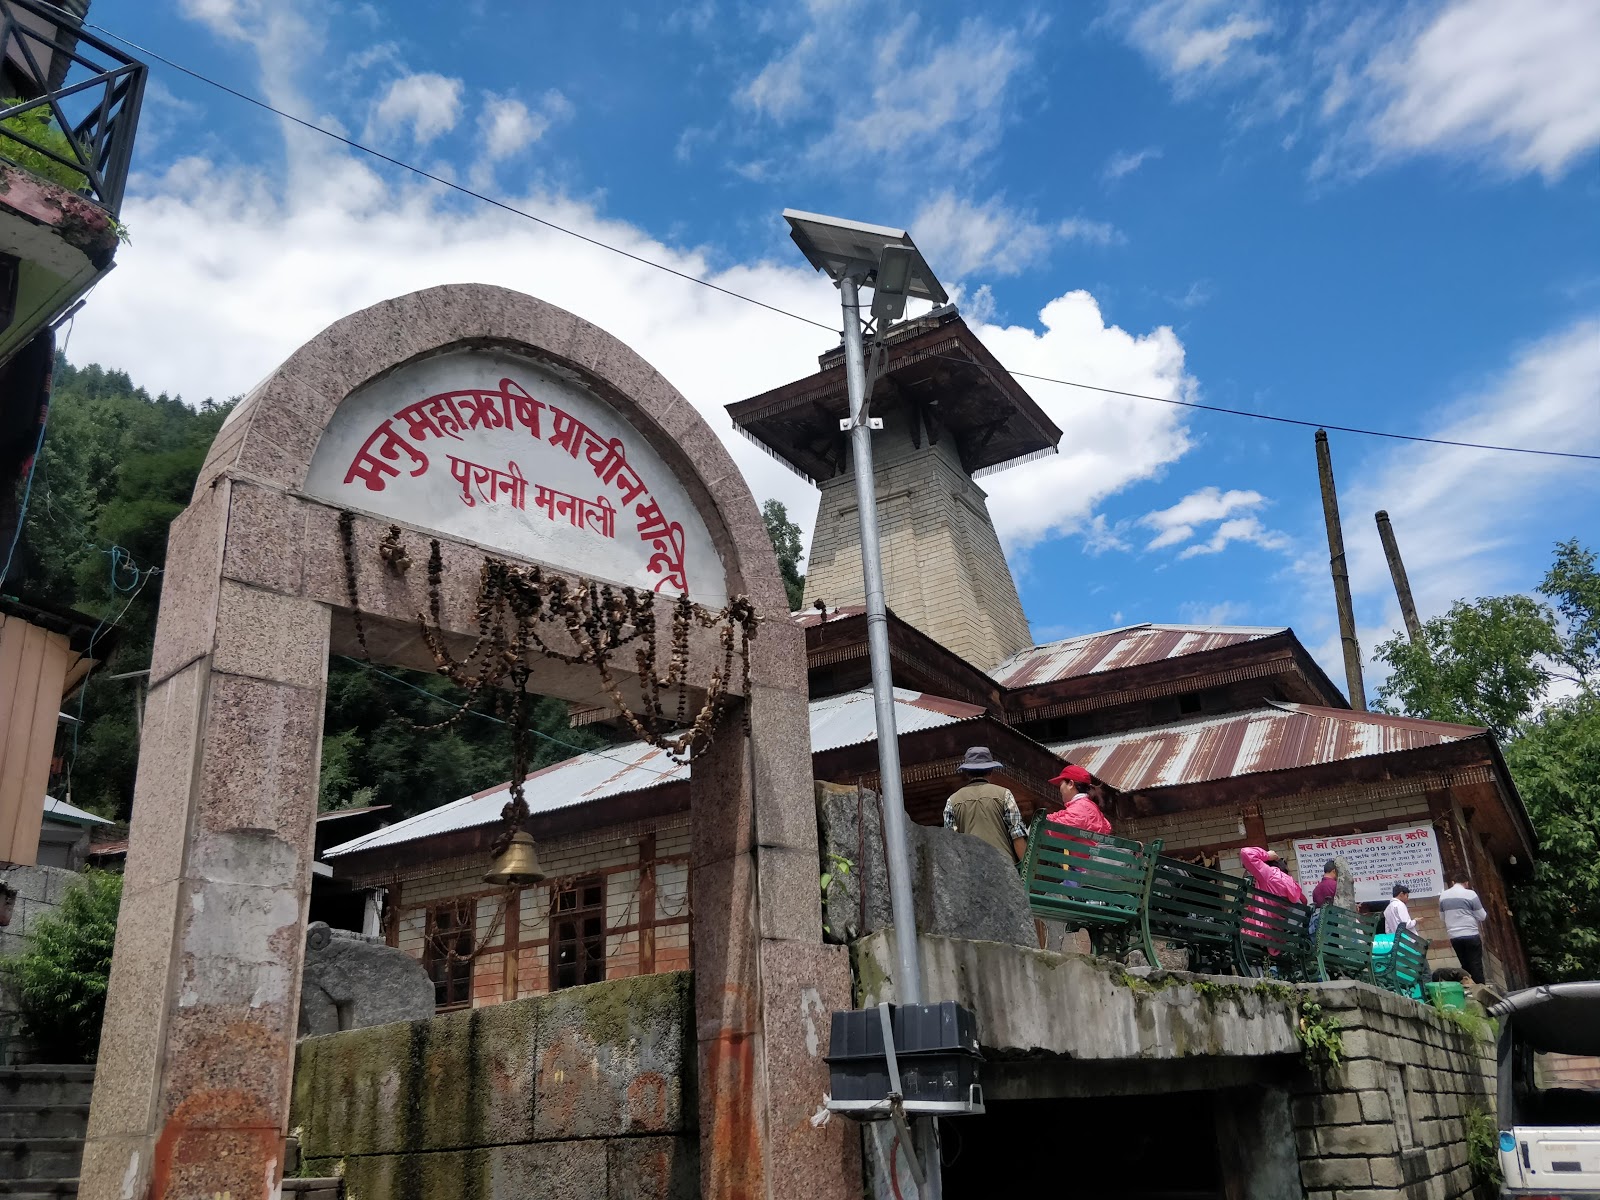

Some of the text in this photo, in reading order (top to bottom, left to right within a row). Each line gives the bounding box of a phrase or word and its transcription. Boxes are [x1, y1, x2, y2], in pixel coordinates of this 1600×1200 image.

[343, 419, 430, 492] मनु
[394, 377, 546, 441] महाऋषि
[548, 404, 649, 507] प्राचीन
[445, 454, 617, 539] पुरानी मनाली
[1298, 843, 1313, 851] जय
[1365, 836, 1382, 844] जय
[1385, 834, 1404, 844] मनु
[1405, 829, 1428, 840] ऋषि
